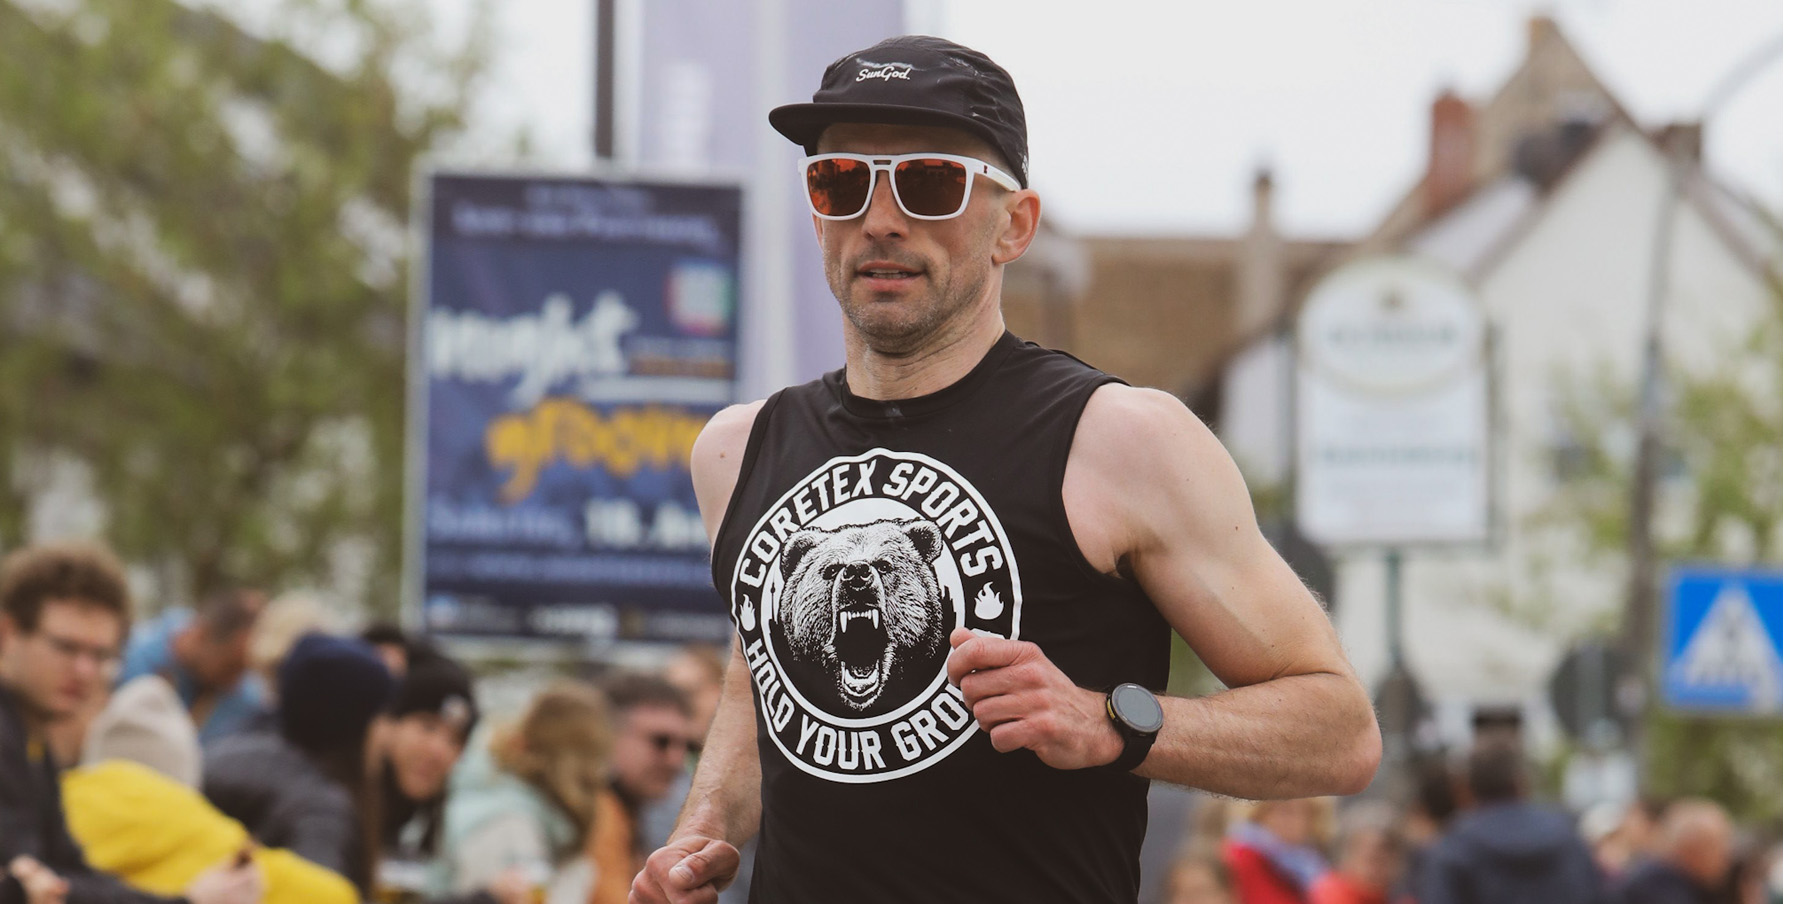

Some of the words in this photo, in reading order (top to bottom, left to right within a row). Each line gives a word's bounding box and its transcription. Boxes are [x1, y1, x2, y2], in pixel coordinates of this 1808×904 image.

[740, 459, 877, 588] CORETEX
[882, 462, 1003, 578] SPORTS
[746, 638, 796, 733] HOLD
[796, 713, 886, 770] YOUR
